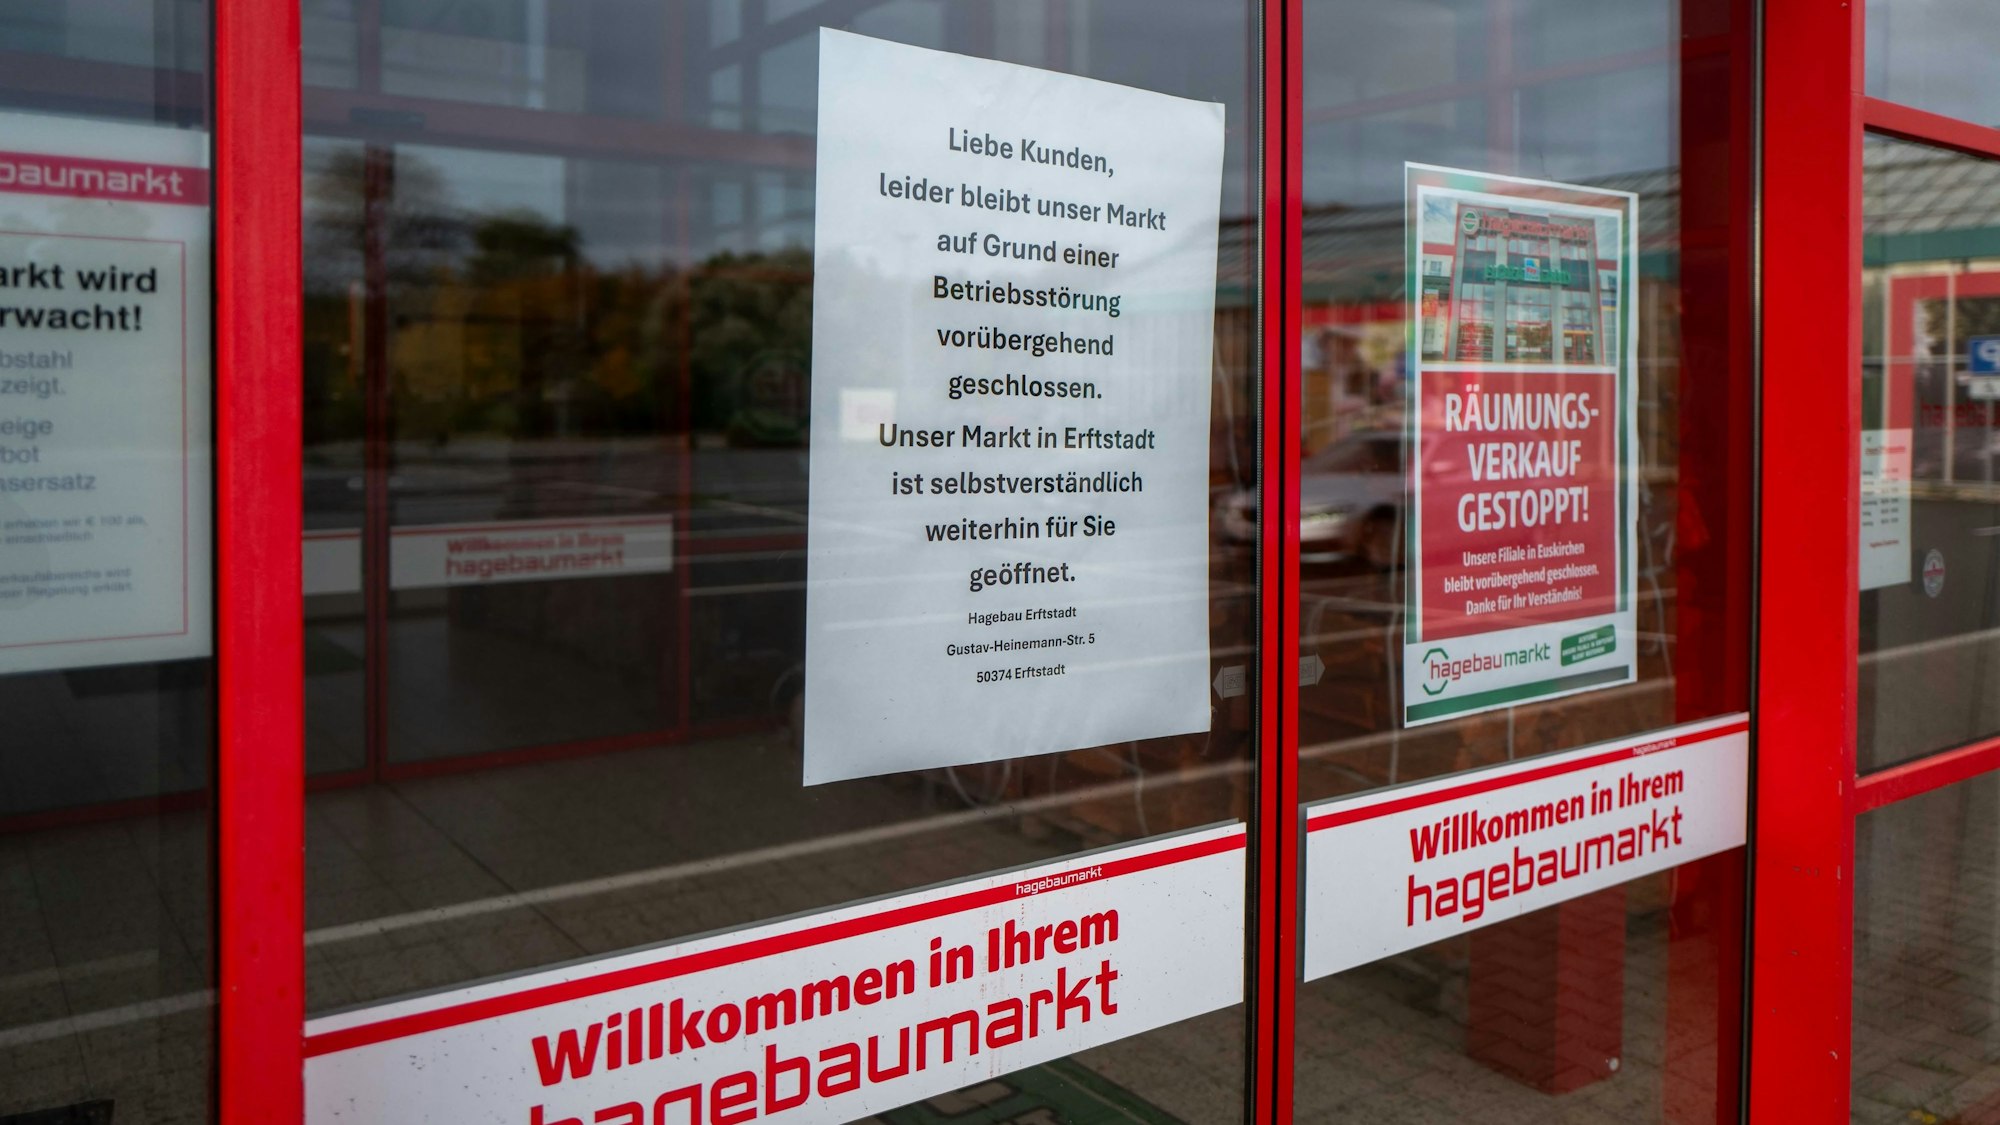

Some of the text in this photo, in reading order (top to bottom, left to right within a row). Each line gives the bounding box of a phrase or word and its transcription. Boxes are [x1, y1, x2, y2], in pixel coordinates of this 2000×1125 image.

[949, 127, 1114, 178] Liebe Kunden,
[880, 173, 1166, 231] leider bleibt unser Markt
[937, 232, 1119, 268] auf Grund einer
[76, 265, 157, 294] wird
[933, 276, 1121, 318] Betriebsstörung
[0, 304, 142, 331] rwacht!
[937, 327, 1114, 357] vorübergehend
[948, 375, 1102, 399] geschlossen.
[1446, 384, 1599, 431] RÄUMUNGS-
[879, 423, 1155, 450] Unser Markt in Erftstadt
[1468, 440, 1581, 481] VERKAUF
[892, 471, 1143, 495] ist selbstverständlich
[1458, 486, 1589, 532] GESTOPPT!
[925, 515, 1116, 542] weiterhin für Sie
[1463, 541, 1585, 567] Unsere Filiale in Euskirchen
[969, 562, 1076, 592] geöffnet.
[1444, 563, 1599, 593] bleibt vorübergehend geschlossen.
[1466, 585, 1582, 616] Danke für Ihr Verständnis!
[968, 606, 1077, 626] Hagebau Erftstadt
[946, 633, 1095, 657] Gustav-Heinemann-Str. 5
[976, 664, 1065, 683] 50374 Erftstadt
[1410, 768, 1684, 863] Willkommen in Ihrem
[1015, 866, 1103, 895] hagebaumarkt
[1407, 805, 1683, 927] hagebaumarkt
[531, 909, 1119, 1087] Willkommen in Ihrem
